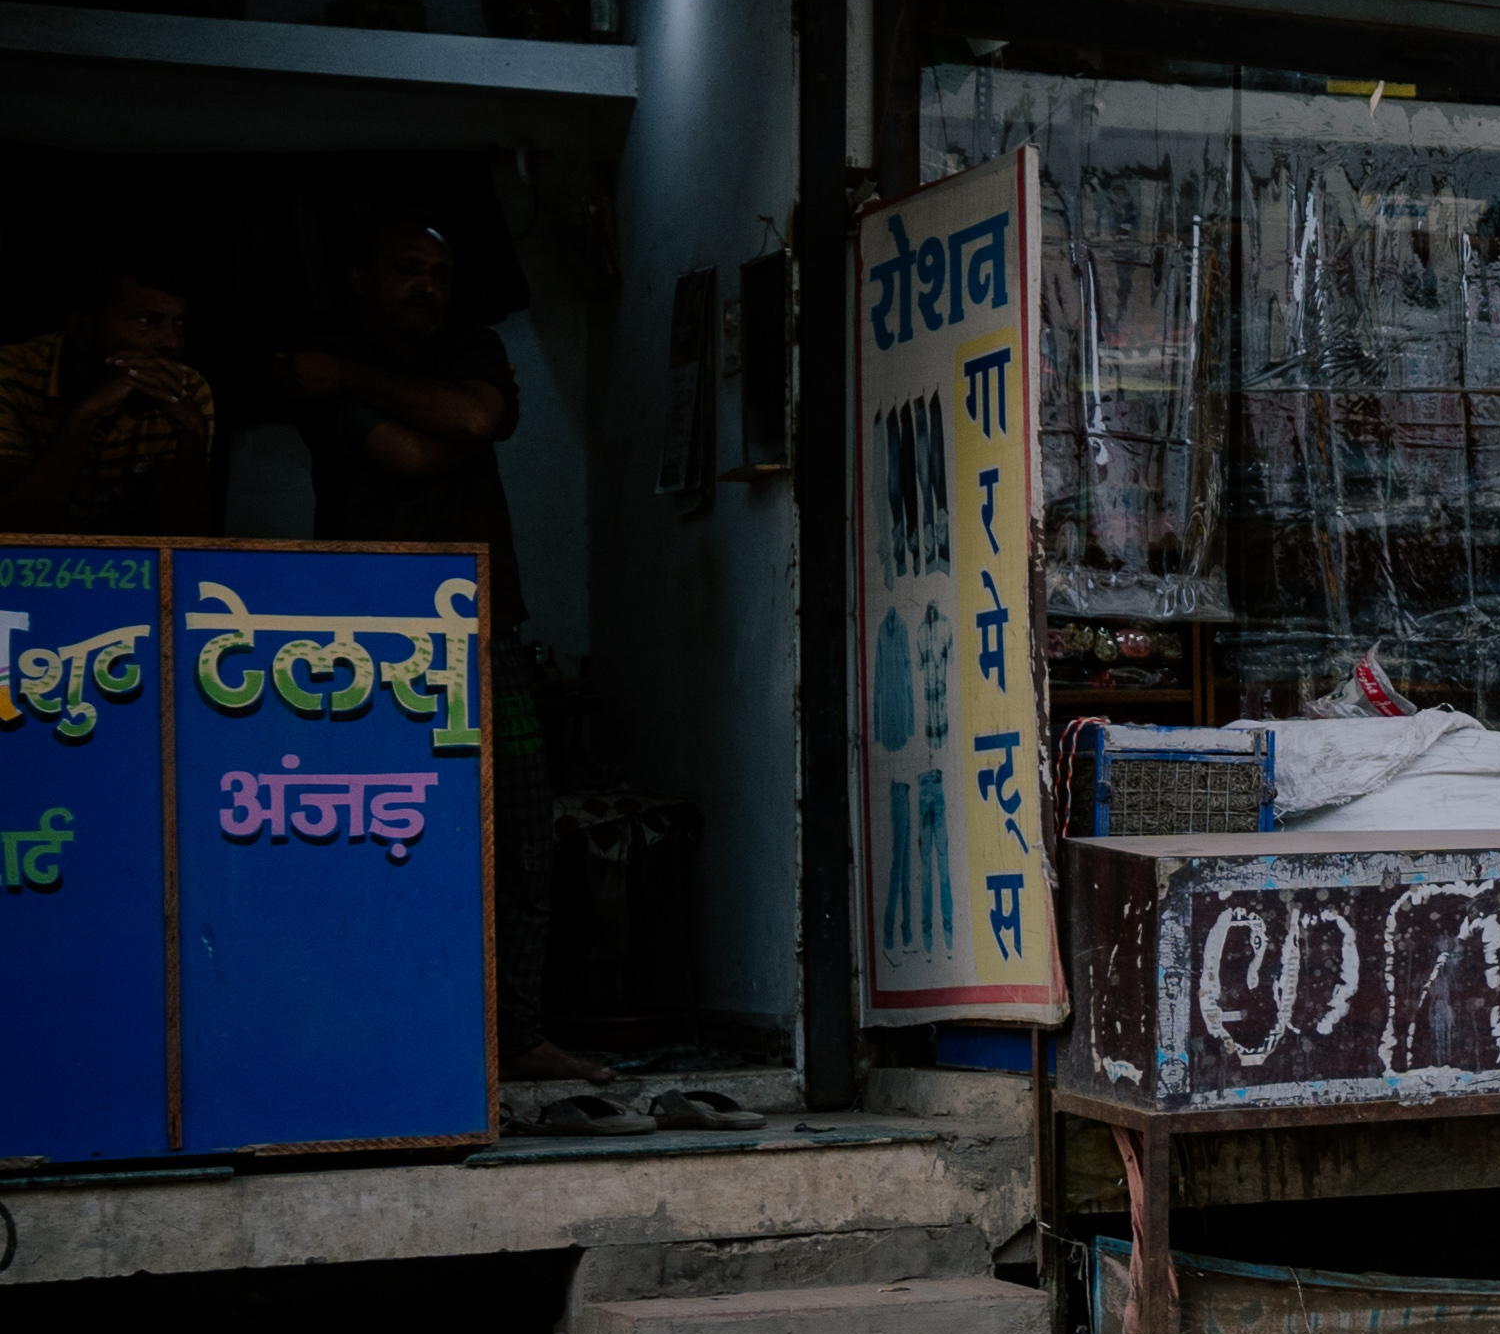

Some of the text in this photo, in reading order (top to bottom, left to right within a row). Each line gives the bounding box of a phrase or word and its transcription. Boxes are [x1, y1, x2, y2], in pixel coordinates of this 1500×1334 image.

[870, 212, 1009, 351] रोशन
[186, 578, 481, 747] टेलर्स
[220, 754, 438, 857] अंजड़
